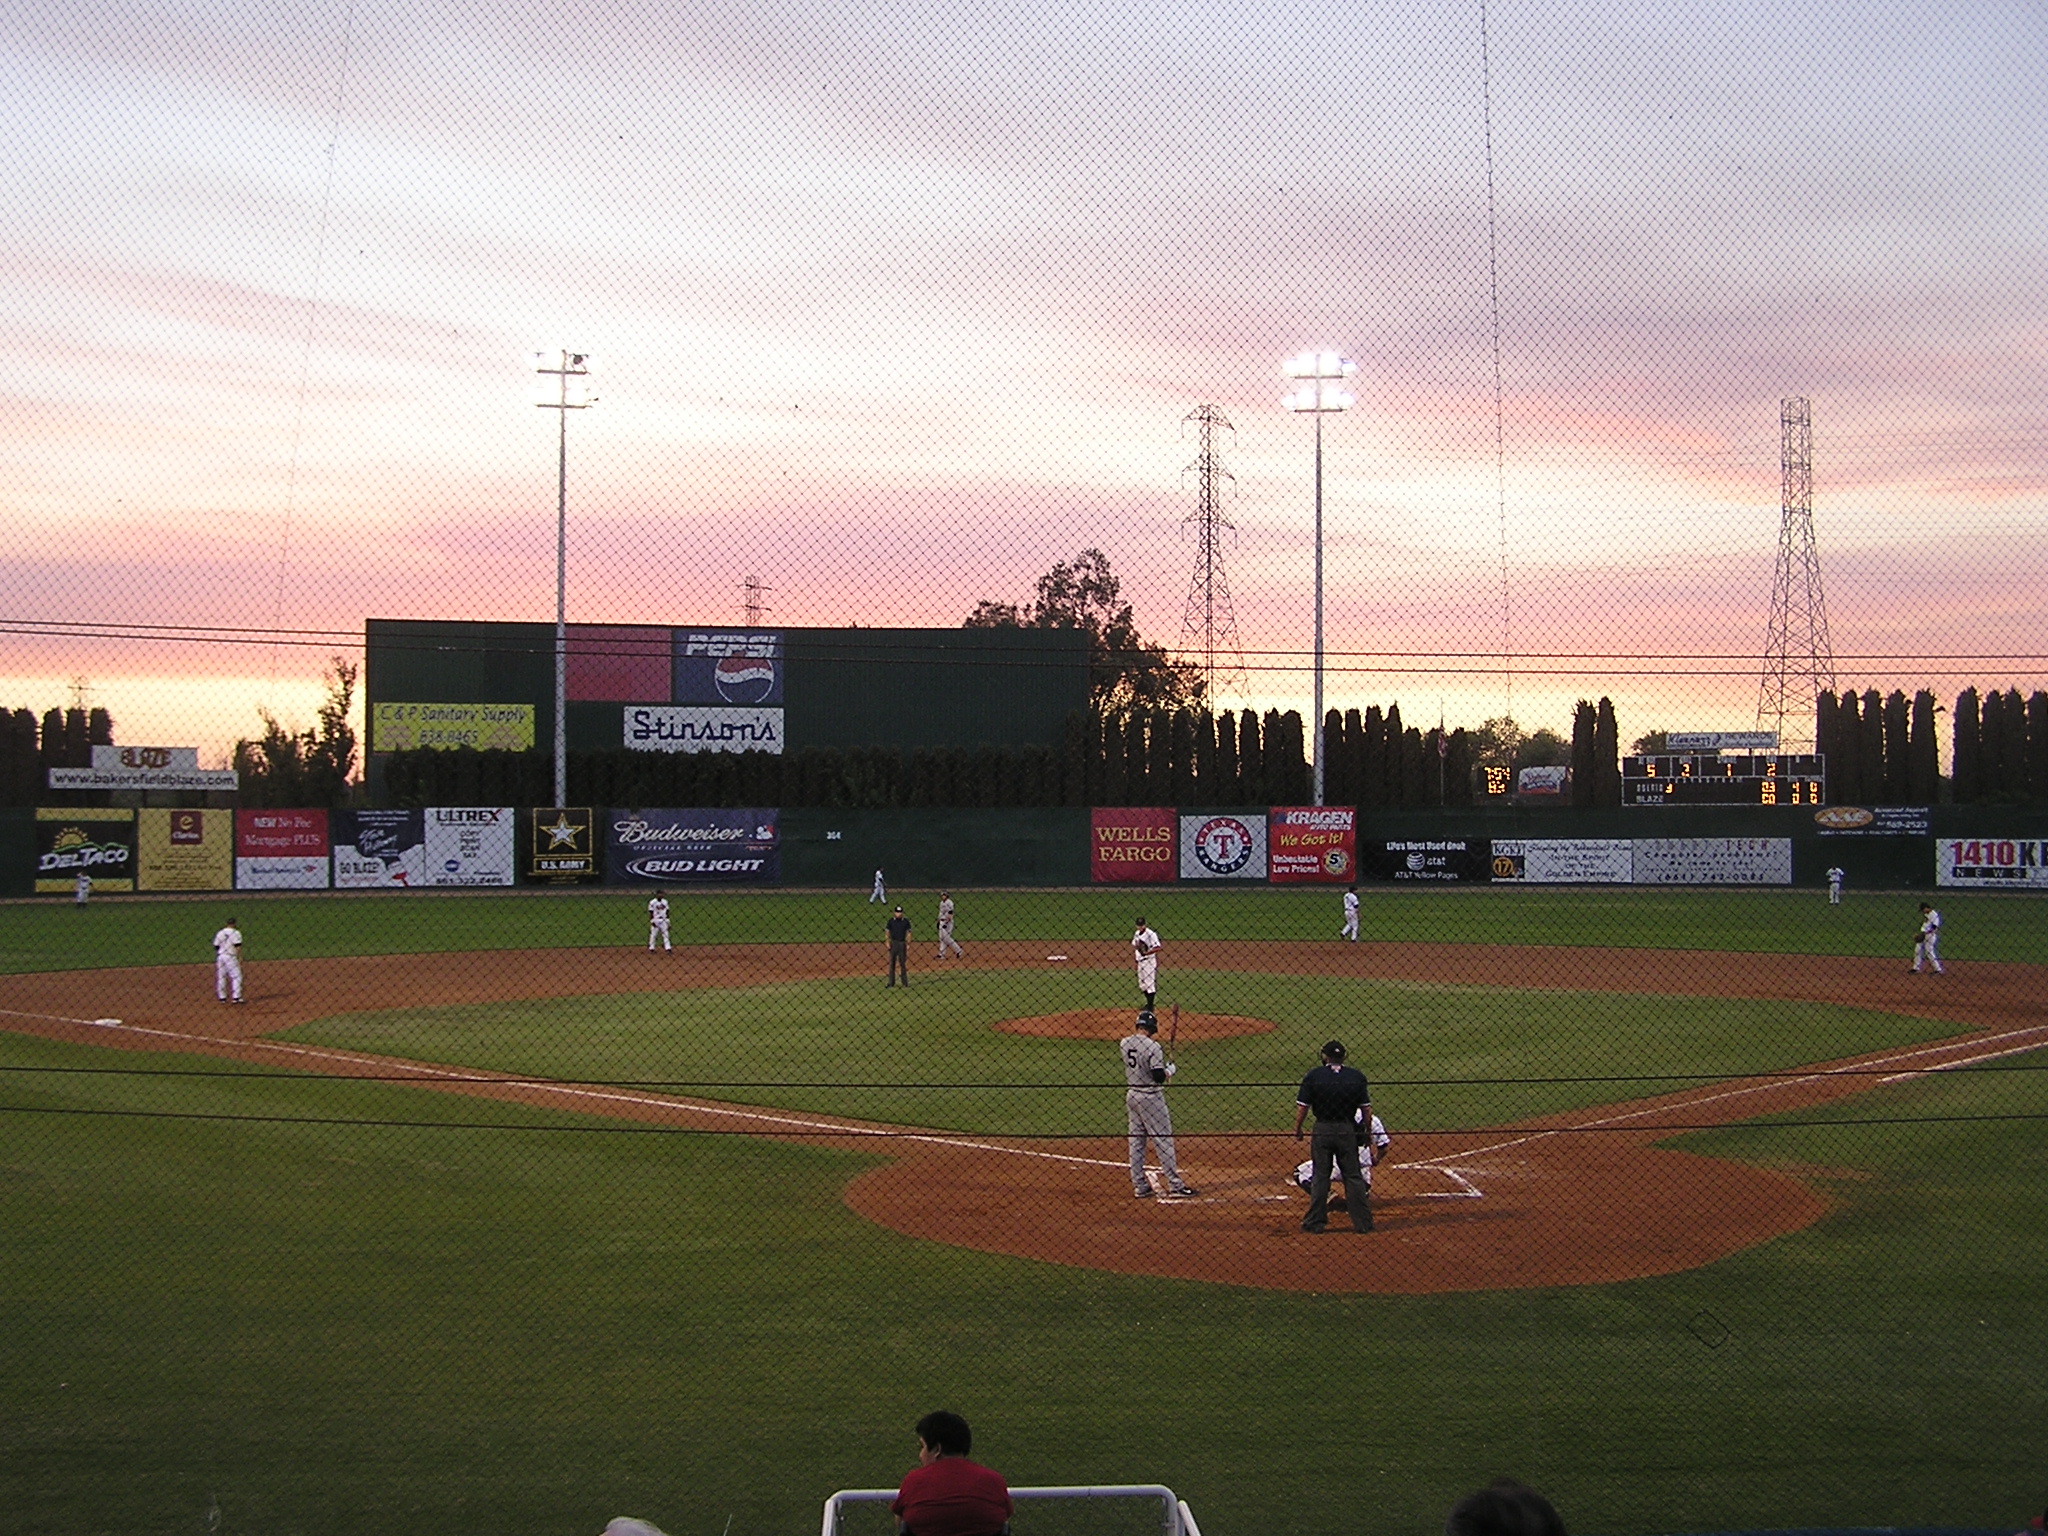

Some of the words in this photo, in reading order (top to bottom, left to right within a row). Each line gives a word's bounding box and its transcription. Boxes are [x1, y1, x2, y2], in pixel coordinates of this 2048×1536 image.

[686, 634, 776, 658] PEPSI
[381, 706, 392, 720] C
[409, 706, 418, 720] P
[421, 706, 478, 723] Sanitary
[481, 706, 526, 724] Supply
[633, 710, 776, 741] Stinson's
[55, 773, 235, 786] www.bakersfieldblaze.com
[436, 808, 502, 822] ULTREX
[1285, 811, 1353, 825] KRAGEN
[613, 820, 744, 843] Budweiser
[1095, 826, 1171, 842] WELLS
[1280, 834, 1299, 846] We
[1301, 833, 1326, 846] Got
[1328, 831, 1344, 844] It!
[1099, 846, 1171, 862] FARGO
[1213, 834, 1235, 860] T
[1950, 841, 2015, 865] 1410
[644, 860, 694, 872] BUD
[695, 859, 764, 872] LIGHT
[1956, 868, 2021, 878] NEWS
[1128, 1049, 1137, 1068] 5
